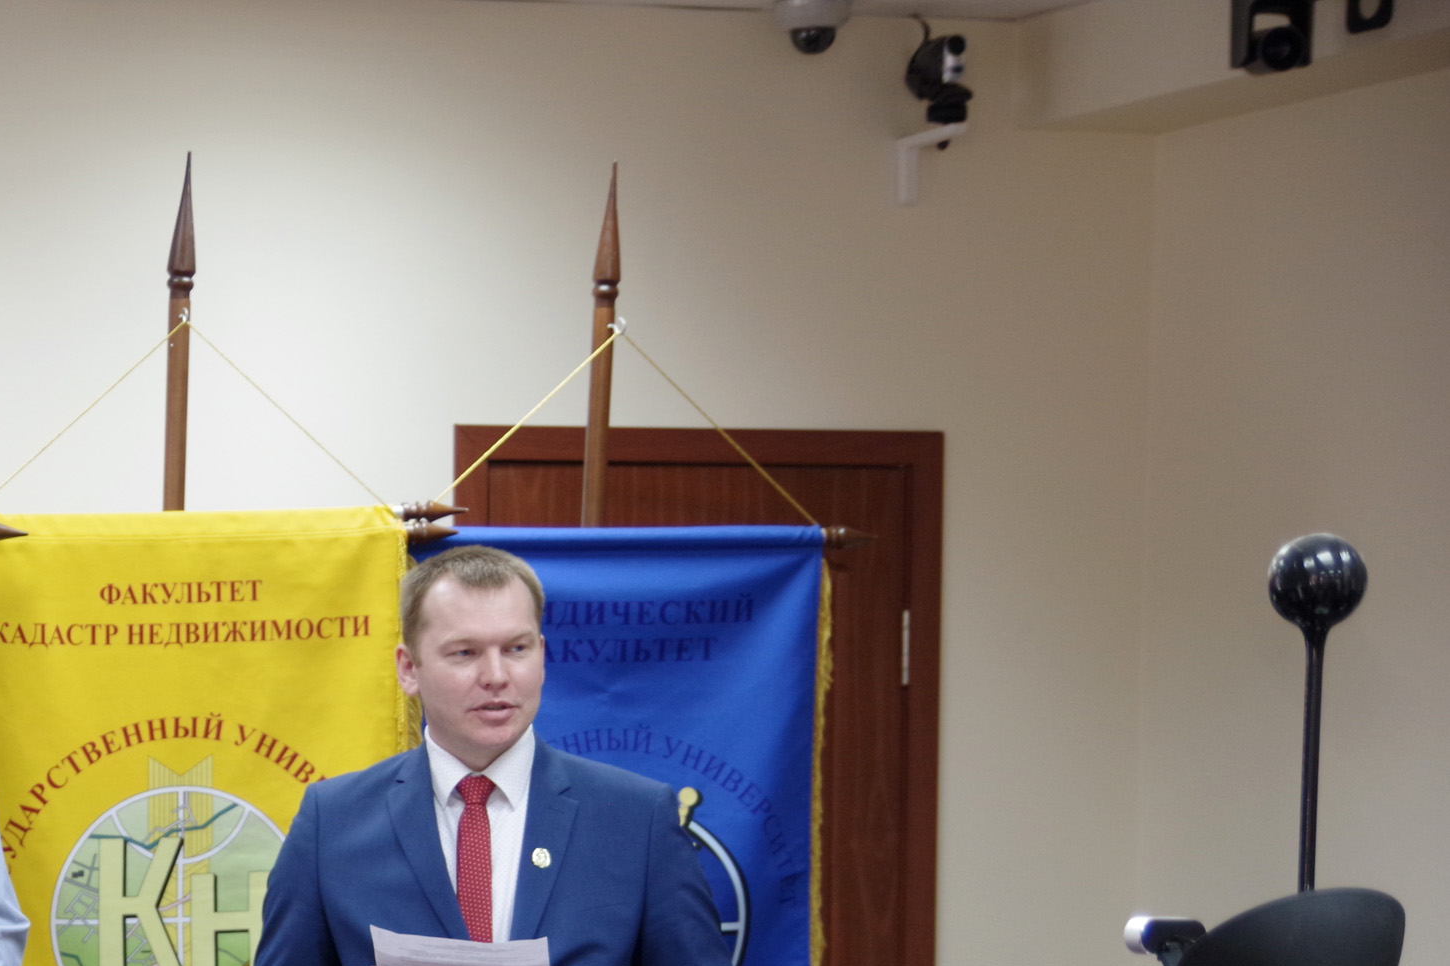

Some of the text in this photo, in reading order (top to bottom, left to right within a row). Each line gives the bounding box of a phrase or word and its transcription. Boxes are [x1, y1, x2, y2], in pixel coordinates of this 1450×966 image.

[99, 579, 263, 606] ФАКУЛЬТЕТ
[126, 613, 371, 648] НЕДВИЖИМОСТИ
[1, 712, 328, 875] УДАРСТВЕННЫЙ УНИВ
